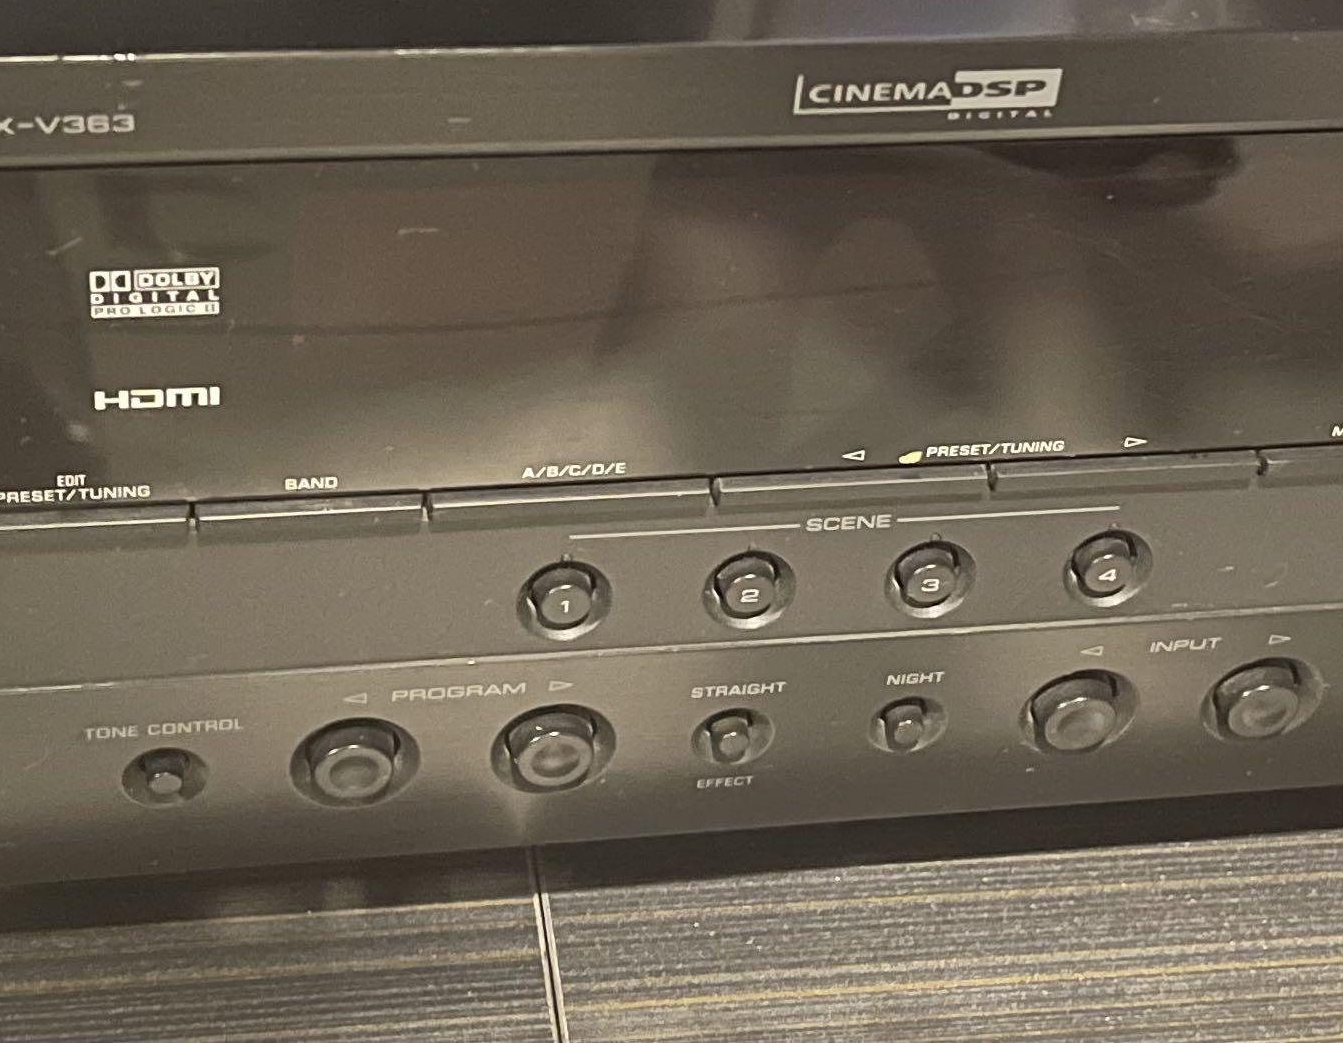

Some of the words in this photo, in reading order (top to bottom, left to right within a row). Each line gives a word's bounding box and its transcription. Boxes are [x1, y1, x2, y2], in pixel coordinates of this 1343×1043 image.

[947, 108, 1053, 121] DIGITAL
[138, 271, 215, 288] DOLBY
[90, 290, 220, 305] DIGITAL
[94, 306, 131, 317] PRO
[139, 304, 196, 316] LOGIC
[94, 386, 221, 411] HDMI
[925, 440, 1065, 458] PRESET/TUNING
[521, 461, 627, 479] A/B/C/D/E
[56, 474, 87, 488] EDIT
[284, 476, 338, 491] BAND
[806, 514, 892, 533] SCENE
[1097, 566, 1119, 583] 4
[920, 577, 941, 593] 3
[739, 587, 761, 604] 2
[559, 598, 571, 616] 1
[1149, 636, 1222, 654] INPUT
[886, 670, 945, 686] NIGHT
[390, 682, 527, 702] PROGRAM
[690, 681, 787, 700] STRAIGHT
[84, 724, 139, 741] TONE
[147, 717, 244, 737] CONTROL
[696, 775, 755, 790] EFFECT
